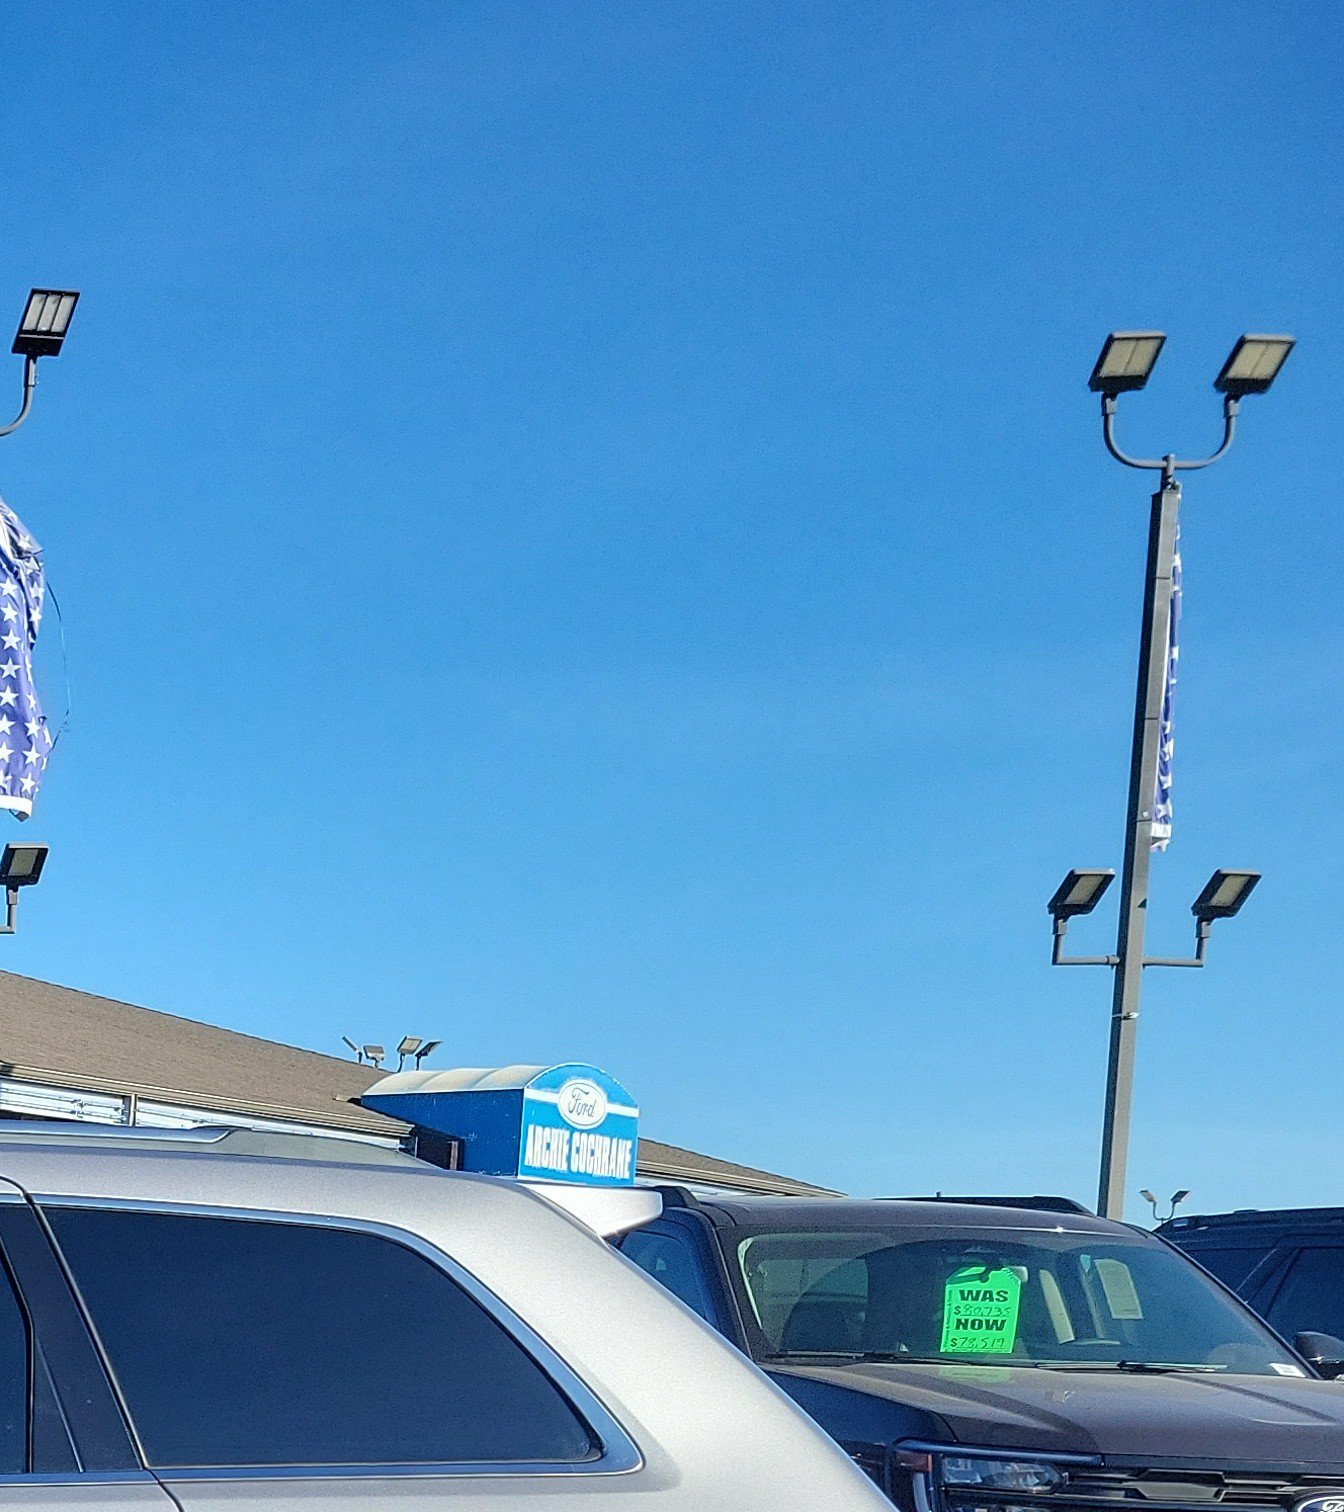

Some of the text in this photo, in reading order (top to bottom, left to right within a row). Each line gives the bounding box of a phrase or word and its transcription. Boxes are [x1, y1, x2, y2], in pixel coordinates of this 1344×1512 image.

[568, 1087, 597, 1118] Ford
[524, 1124, 632, 1179] ARCHIE COCHRANE
[958, 1290, 1009, 1302] WAS
[954, 1318, 1007, 1331] NOW
